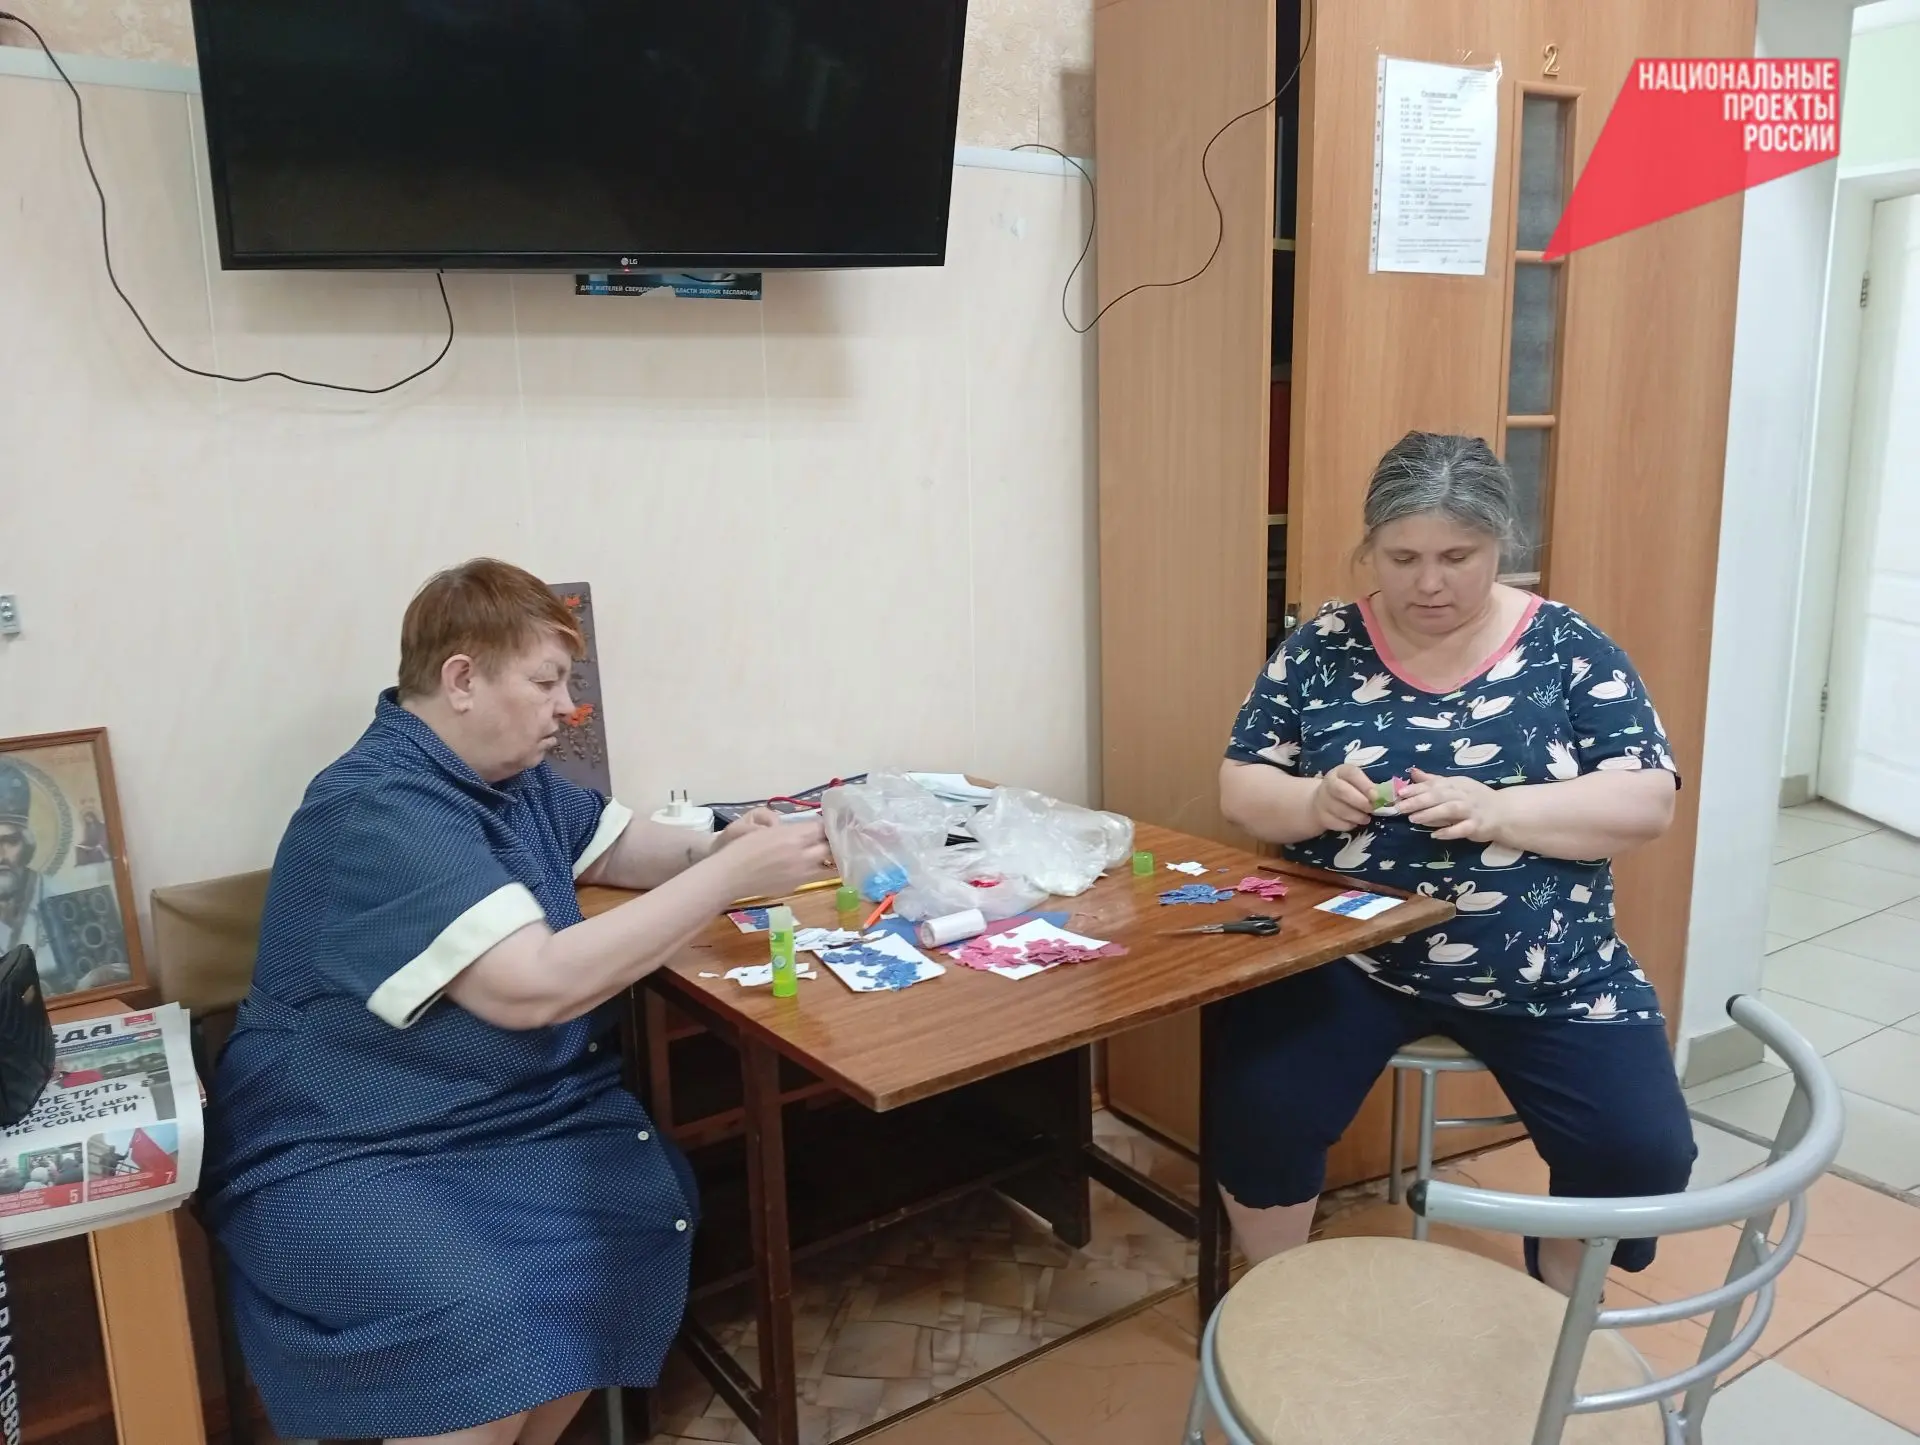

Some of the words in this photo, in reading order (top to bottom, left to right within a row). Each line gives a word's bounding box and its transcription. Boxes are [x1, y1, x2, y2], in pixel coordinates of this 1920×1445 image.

[1543, 43, 1560, 76] 2
[5, 1125, 36, 1138] НЕ
[42, 1102, 137, 1128] СОЦСЕТИ
[165, 1171, 173, 1184] 7
[69, 1189, 79, 1203] 5
